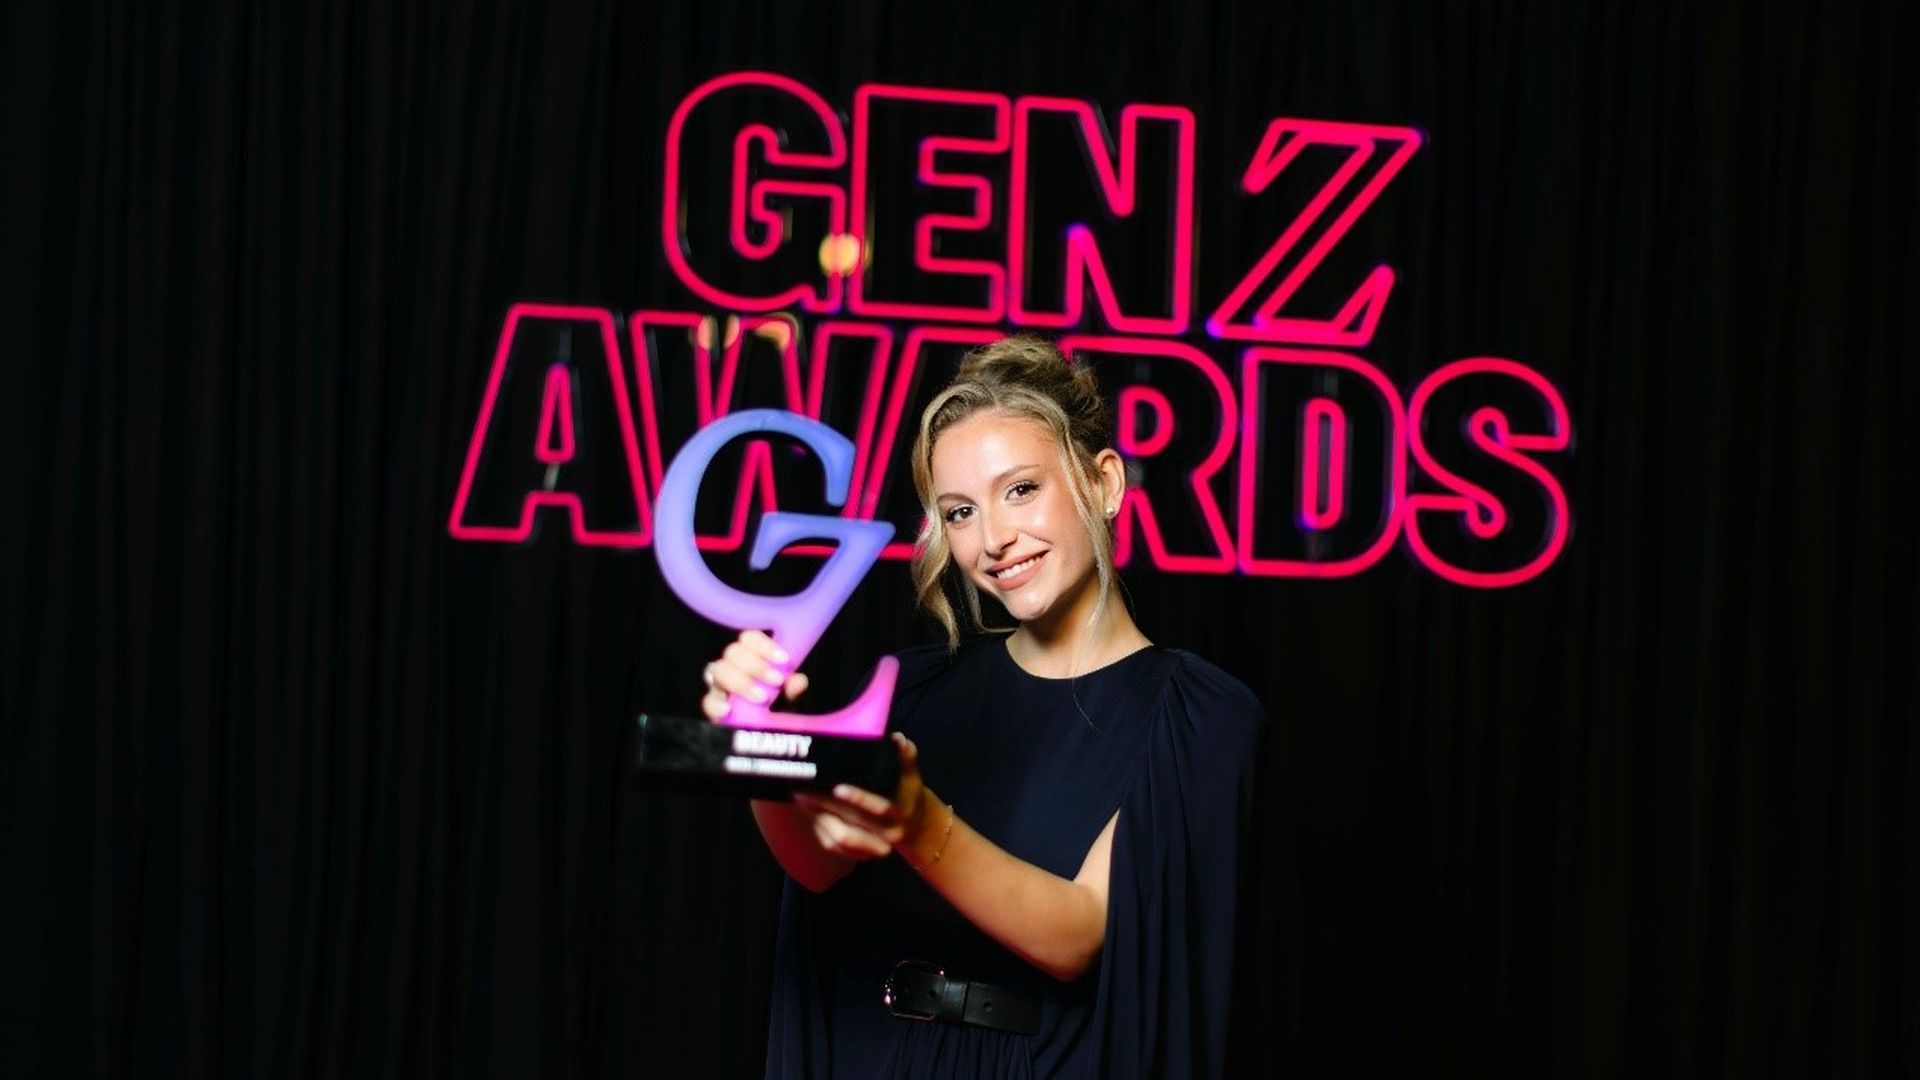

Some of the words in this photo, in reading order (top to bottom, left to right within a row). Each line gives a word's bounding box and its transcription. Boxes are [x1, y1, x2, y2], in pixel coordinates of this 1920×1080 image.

[662, 71, 1196, 336] GEN
[1207, 118, 1423, 346] Z
[733, 729, 812, 757] BEAUTY
